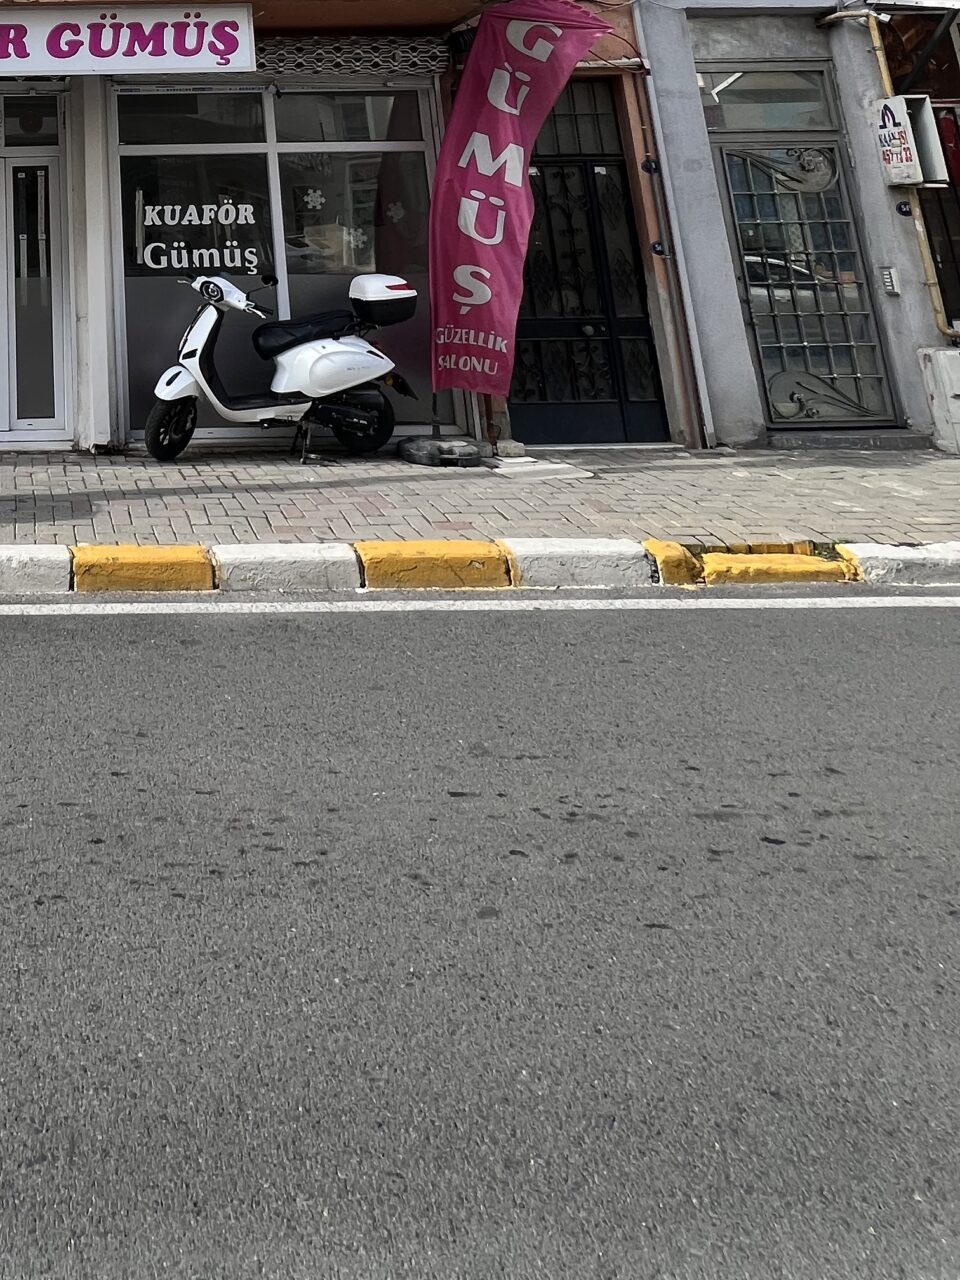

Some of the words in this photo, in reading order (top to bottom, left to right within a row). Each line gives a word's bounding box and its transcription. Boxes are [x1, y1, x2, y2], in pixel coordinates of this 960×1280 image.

[45, 11, 240, 66] GÜMÜŞ
[452, 19, 564, 315] GÜMÜŞ
[143, 199, 256, 226] KUAFÖR
[143, 241, 258, 275] Gümüş
[436, 324, 508, 353] GÜZELLİK
[438, 354, 498, 375] SALONU
